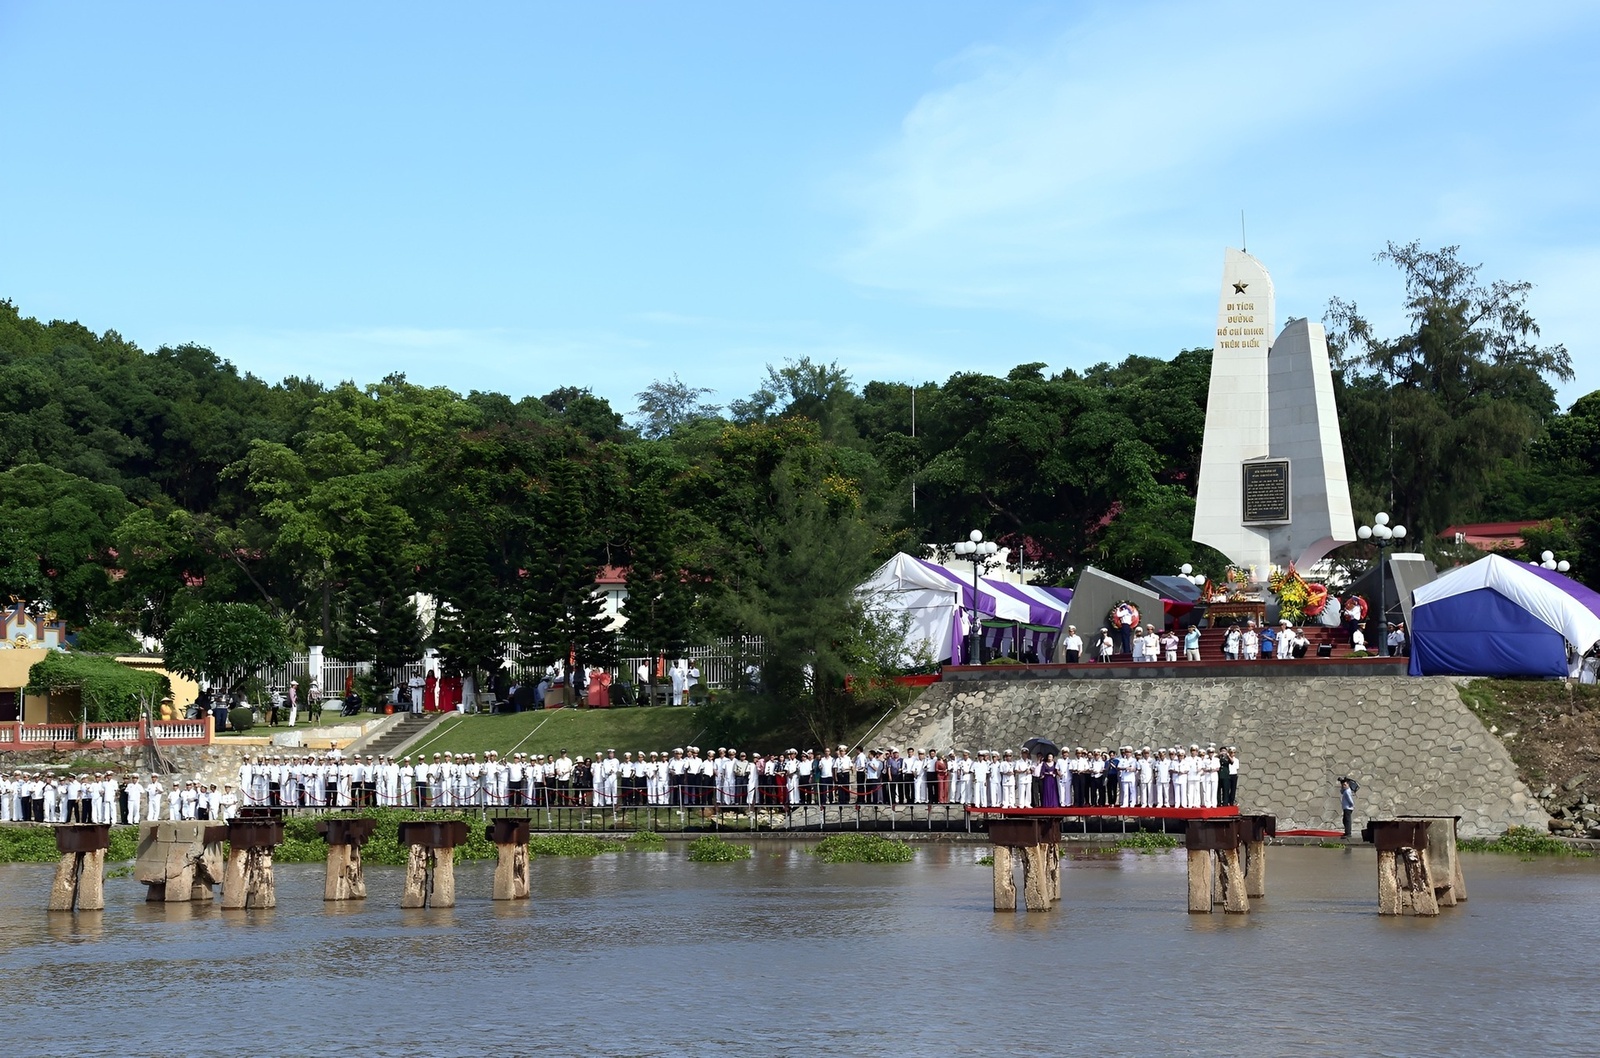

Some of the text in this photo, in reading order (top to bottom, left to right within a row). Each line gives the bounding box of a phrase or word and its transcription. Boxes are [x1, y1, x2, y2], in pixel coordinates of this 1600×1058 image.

[1236, 302, 1254, 311] TÍCH
[1229, 327, 1242, 336] CHÍ
[1243, 327, 1264, 335] MINH
[1220, 339, 1240, 348] TRÊN
